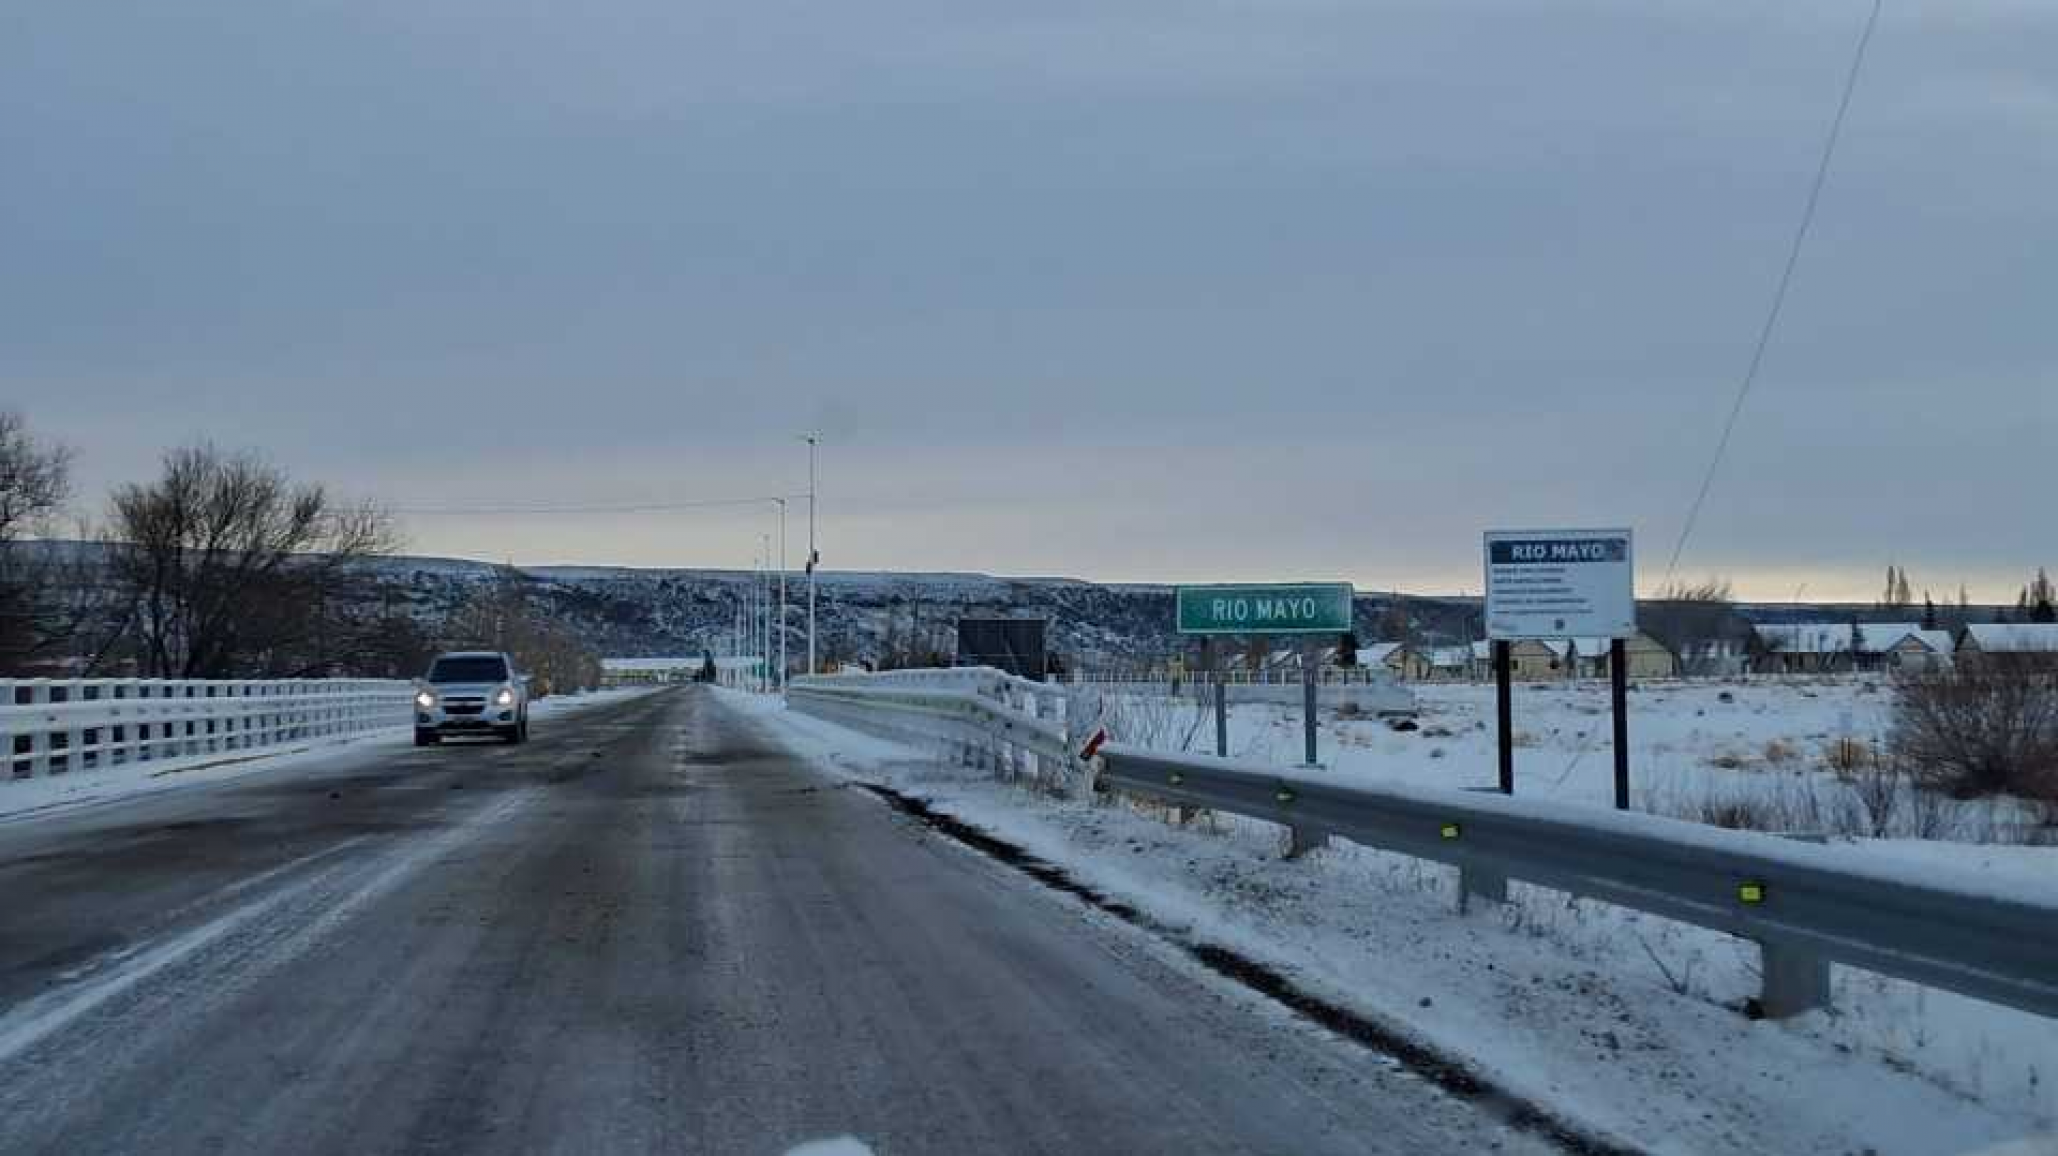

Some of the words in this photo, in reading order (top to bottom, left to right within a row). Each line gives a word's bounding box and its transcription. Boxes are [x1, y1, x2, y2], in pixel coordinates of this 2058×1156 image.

[1511, 544, 1546, 560] RIO
[1551, 543, 1605, 559] MAYO
[1212, 598, 1248, 620] RIO
[1256, 597, 1316, 619] MAYO
